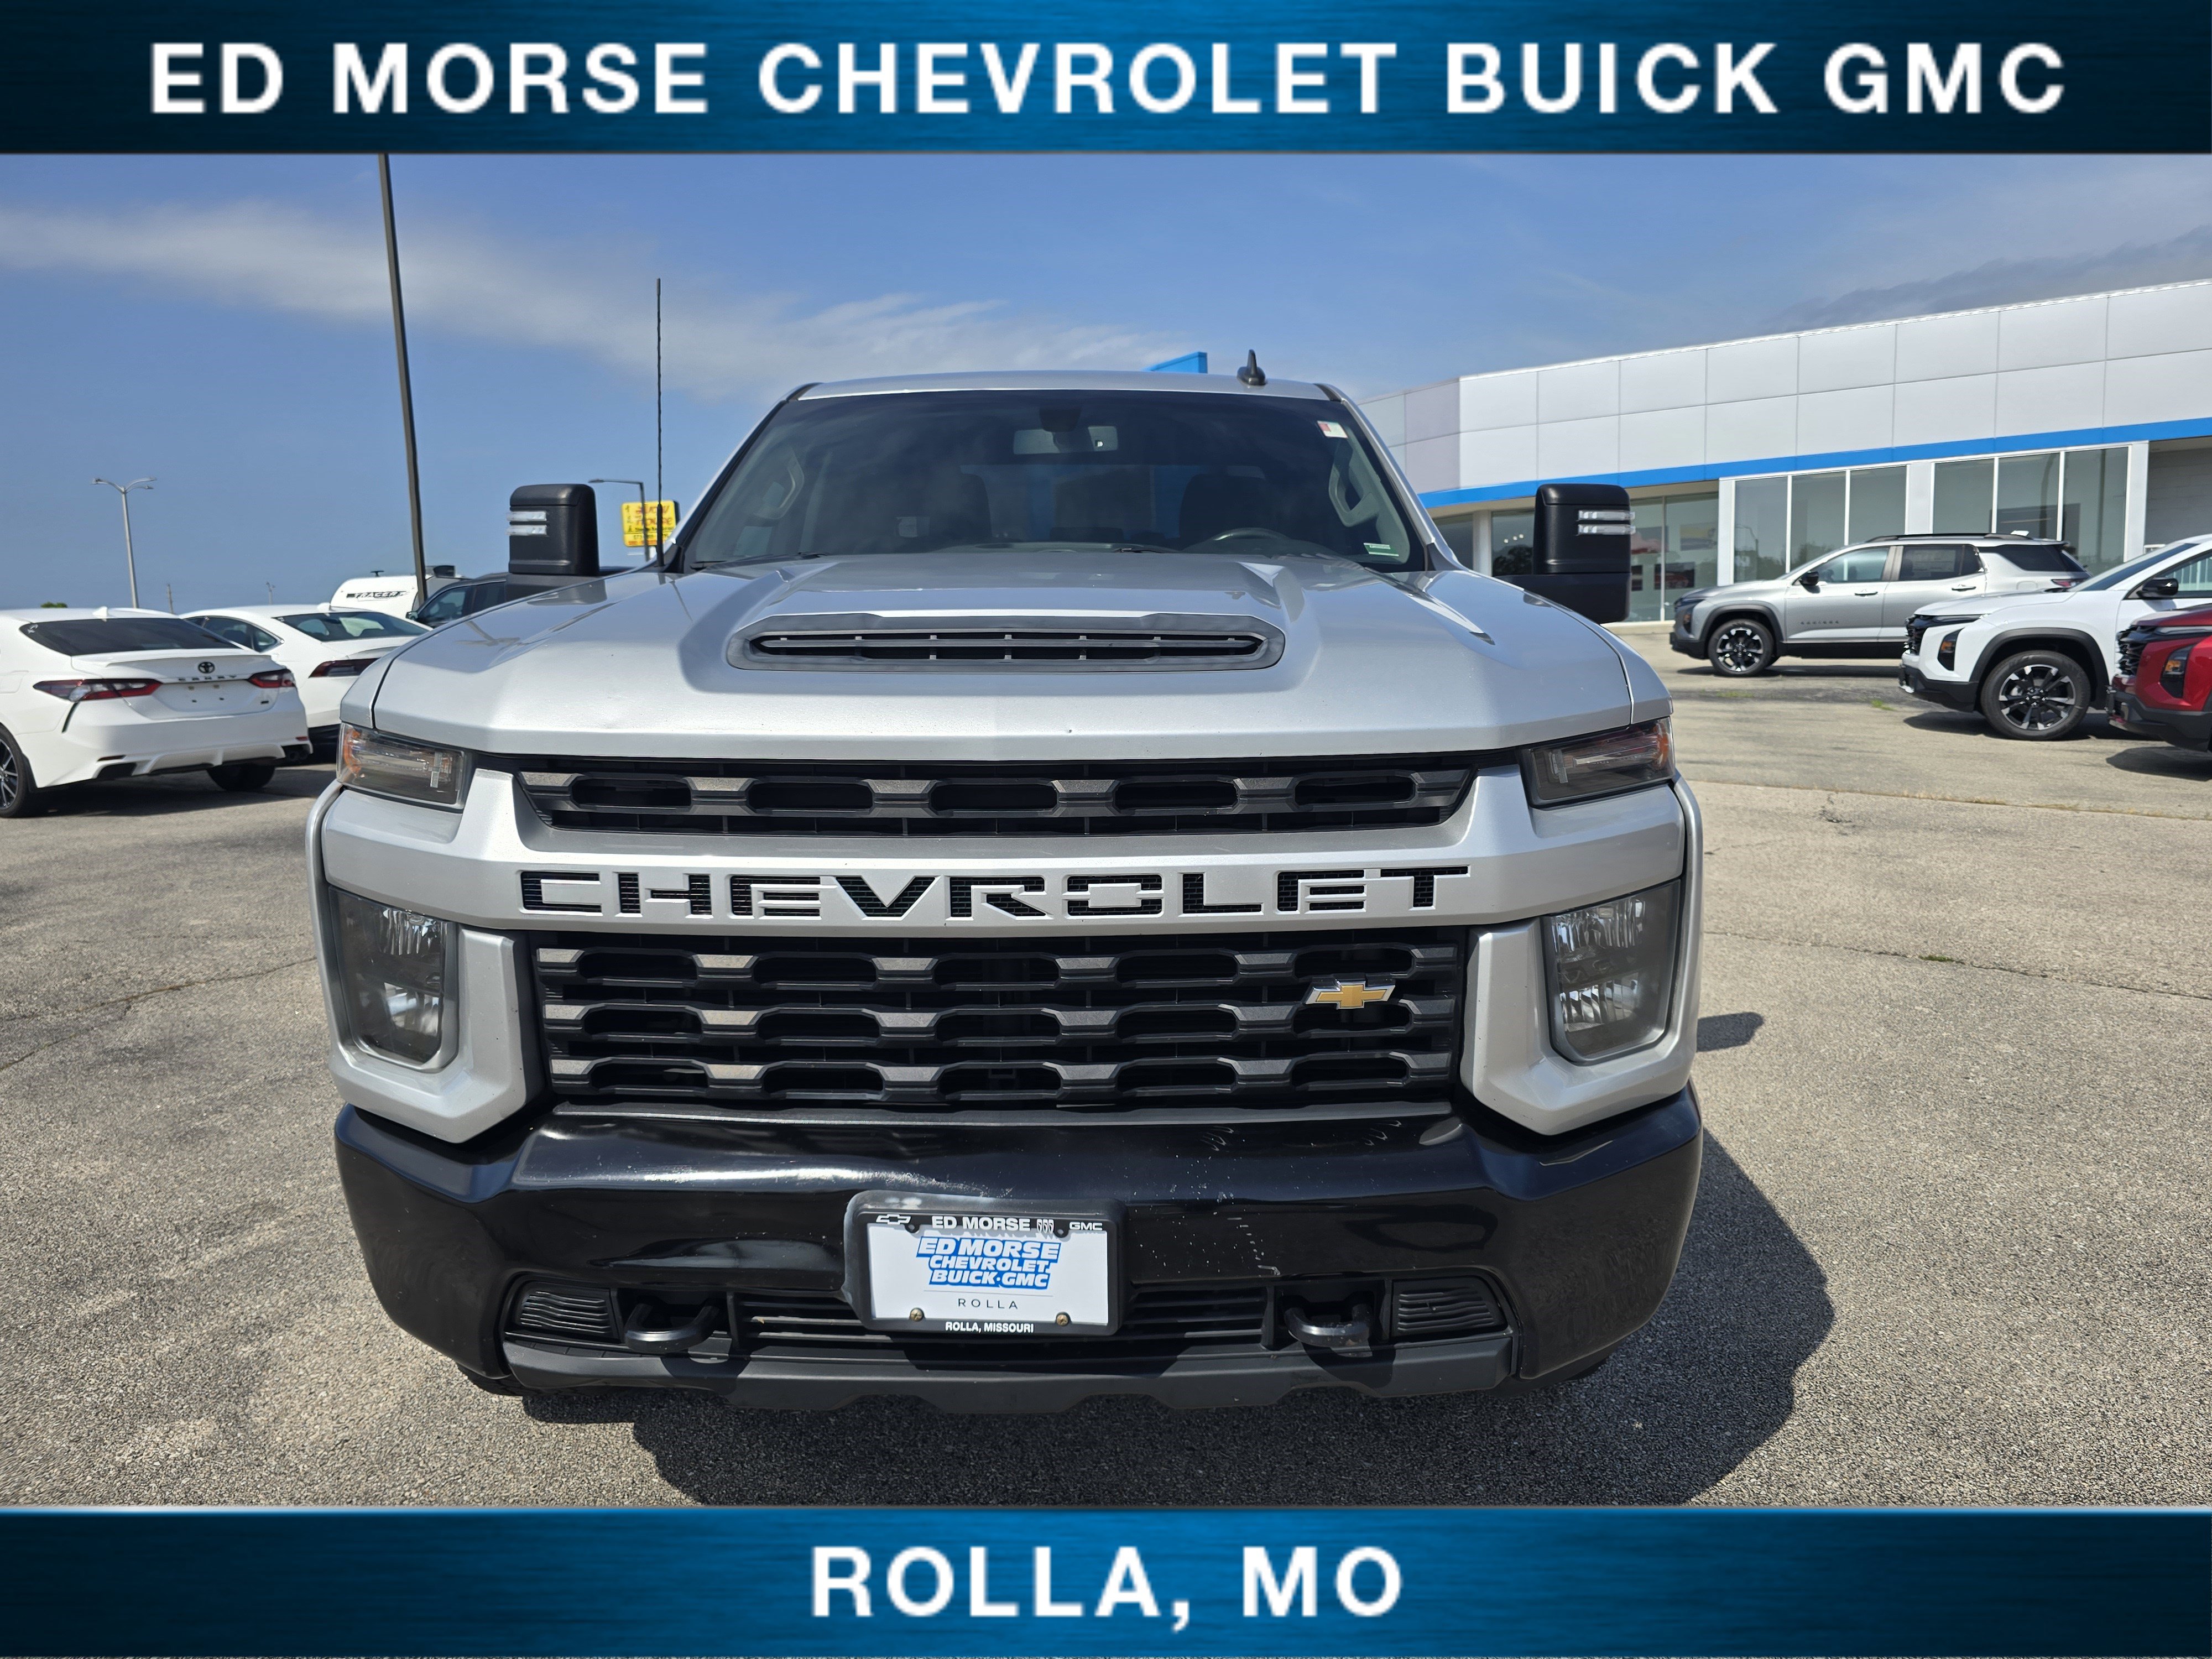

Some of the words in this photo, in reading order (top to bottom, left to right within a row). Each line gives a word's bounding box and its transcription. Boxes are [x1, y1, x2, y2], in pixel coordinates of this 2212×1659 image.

[520, 865, 1470, 920] CHEVROLET
[932, 1215, 957, 1229] ED
[962, 1217, 1031, 1232] MORSE
[1069, 1222, 1103, 1231] GMC
[917, 1237, 957, 1255] ED
[957, 1238, 1059, 1260] MORSE
[957, 1298, 1018, 1310] ROLLA
[945, 1321, 982, 1333] ROLLA,
[983, 1322, 1034, 1333] MISSOURI
